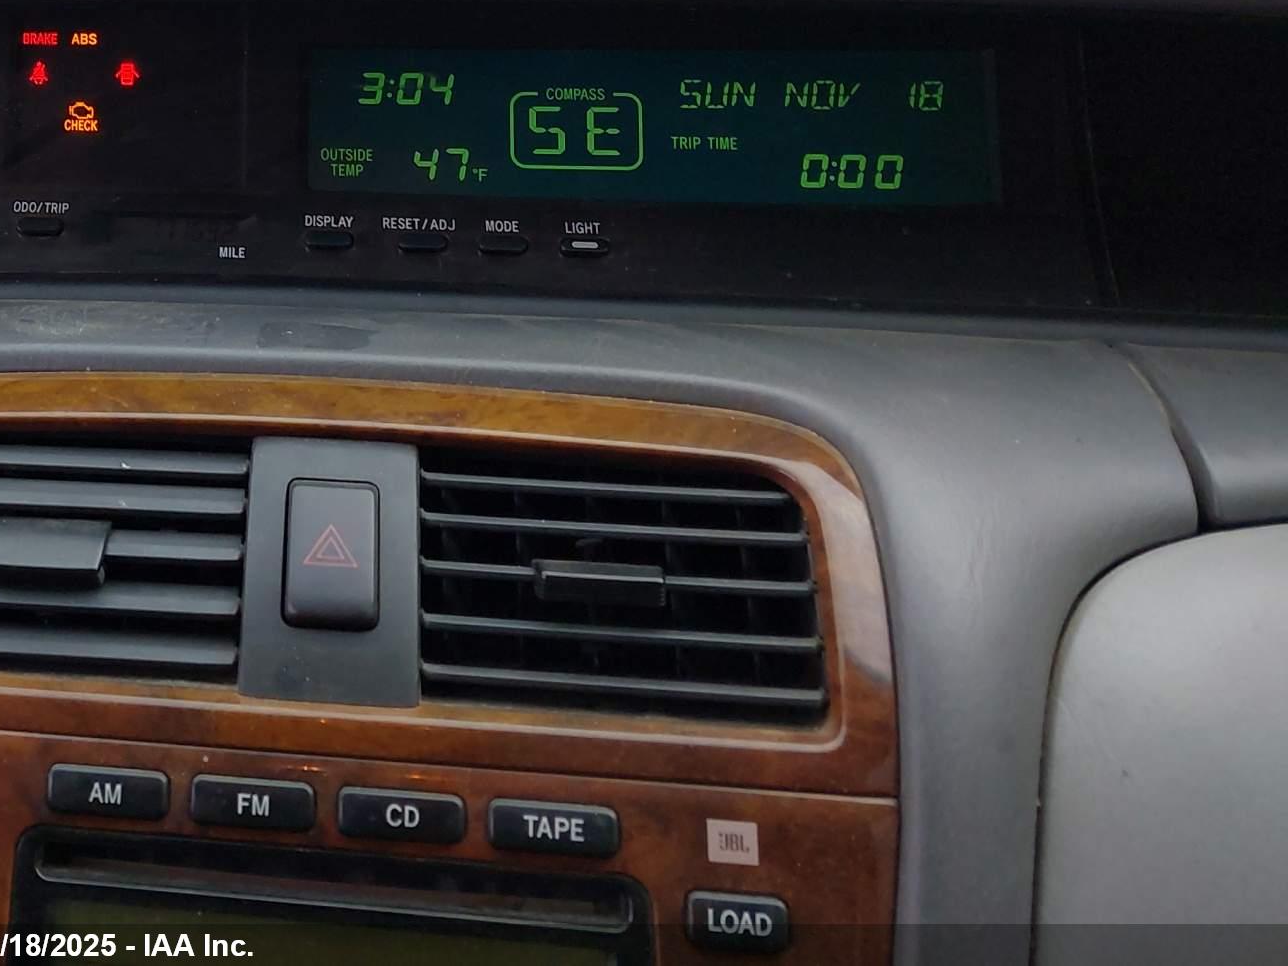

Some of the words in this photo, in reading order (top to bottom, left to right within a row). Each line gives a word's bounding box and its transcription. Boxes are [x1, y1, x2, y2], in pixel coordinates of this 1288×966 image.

[23, 33, 57, 45] BRAKE
[72, 33, 97, 45] ABS
[359, 73, 454, 105] 3:04
[546, 88, 605, 100] COMPASS
[681, 80, 755, 108] SUN
[785, 81, 859, 109] NOV
[910, 82, 943, 110] 18
[64, 119, 98, 131] CHECK
[671, 137, 700, 149] TRIP
[708, 137, 737, 150] TIME
[321, 148, 372, 161] OUTSIDE
[331, 164, 363, 176] TEMP
[801, 154, 903, 189] 0:00
[14, 202, 69, 213] ODO/TRIP
[305, 215, 353, 227] DISPLAY
[486, 221, 518, 232] MODE
[565, 222, 600, 234] LIGHT
[220, 247, 245, 258] MILE
[89, 782, 121, 804] AM
[238, 793, 269, 816] FM
[386, 804, 419, 827] CD
[523, 815, 584, 841] TAPE
[718, 832, 750, 854] JBL
[708, 908, 772, 935] LOAD
